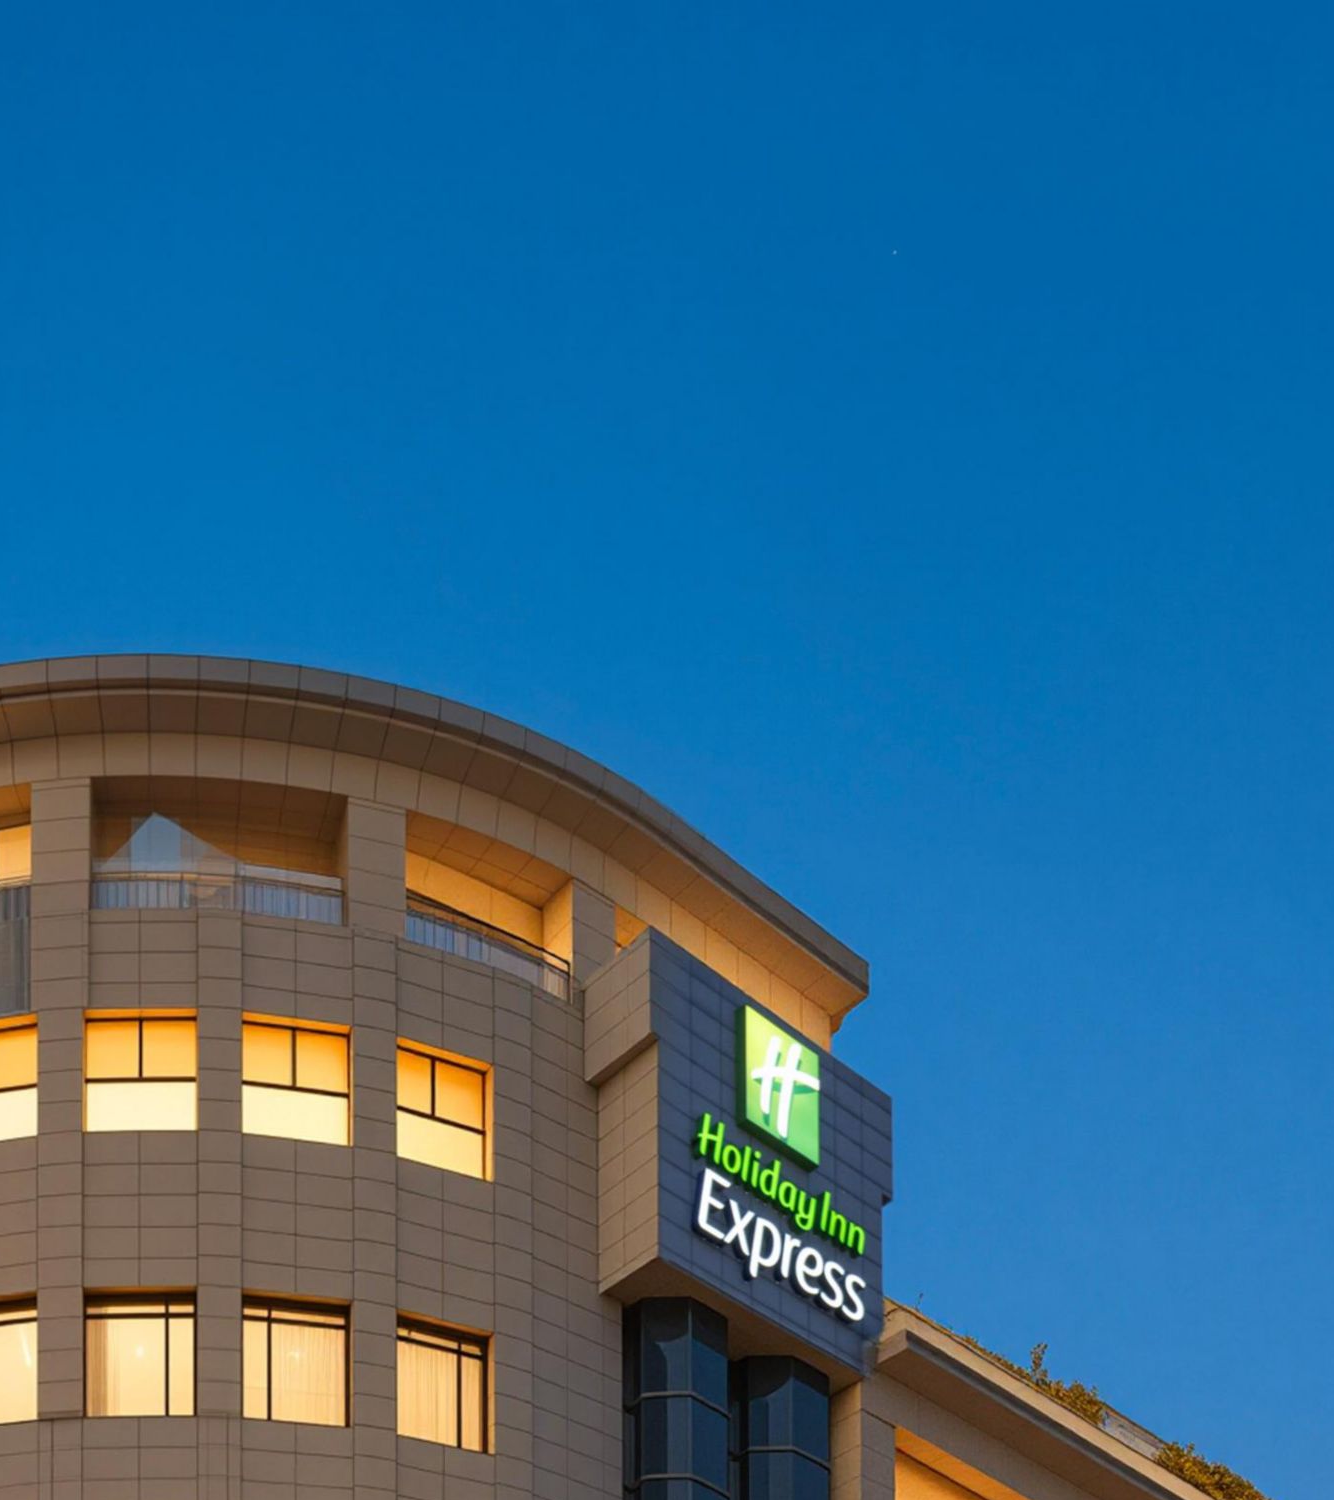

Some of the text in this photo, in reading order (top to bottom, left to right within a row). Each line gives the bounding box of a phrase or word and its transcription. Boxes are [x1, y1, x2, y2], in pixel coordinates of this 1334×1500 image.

[696, 1112, 866, 1255] Holiday Inn
[697, 1167, 866, 1322] Express
